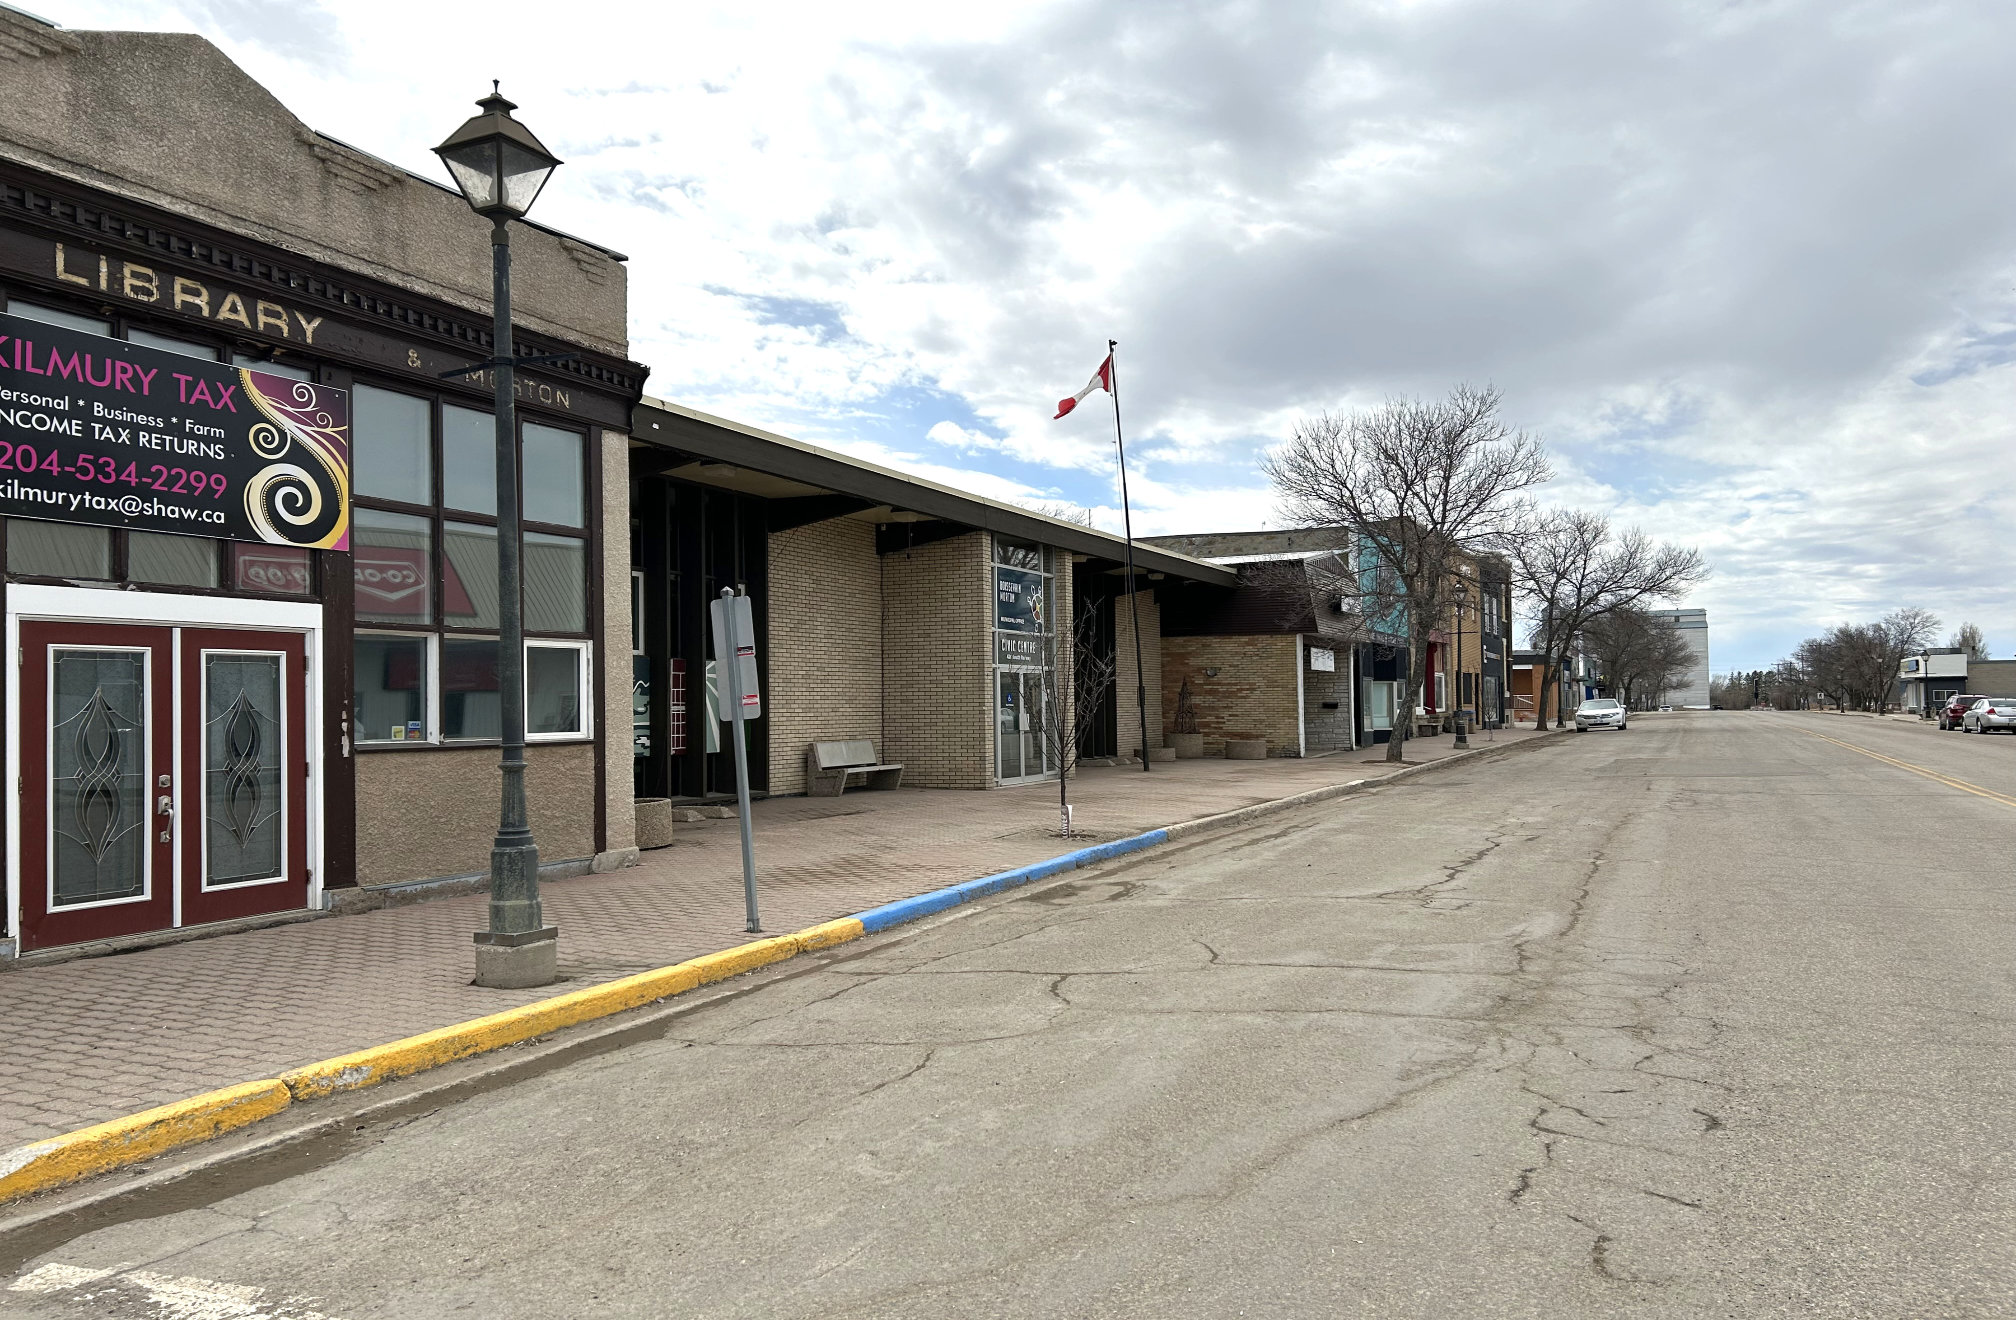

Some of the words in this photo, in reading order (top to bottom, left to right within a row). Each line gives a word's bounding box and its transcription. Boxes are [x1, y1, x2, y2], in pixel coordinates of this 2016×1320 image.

[55, 243, 323, 344] LIBRARY
[407, 349, 421, 368] &
[0, 386, 69, 411] ersonal
[93, 402, 164, 428] Business
[186, 419, 225, 438] Farm
[172, 372, 237, 413] TAX
[0, 409, 82, 437] NCOME
[91, 422, 130, 445] TAX
[139, 431, 225, 460] RETURNS
[0, 441, 227, 499] 204-534-2299
[1001, 638, 1016, 652] CIVIC
[1017, 640, 1036, 654] CENTRE
